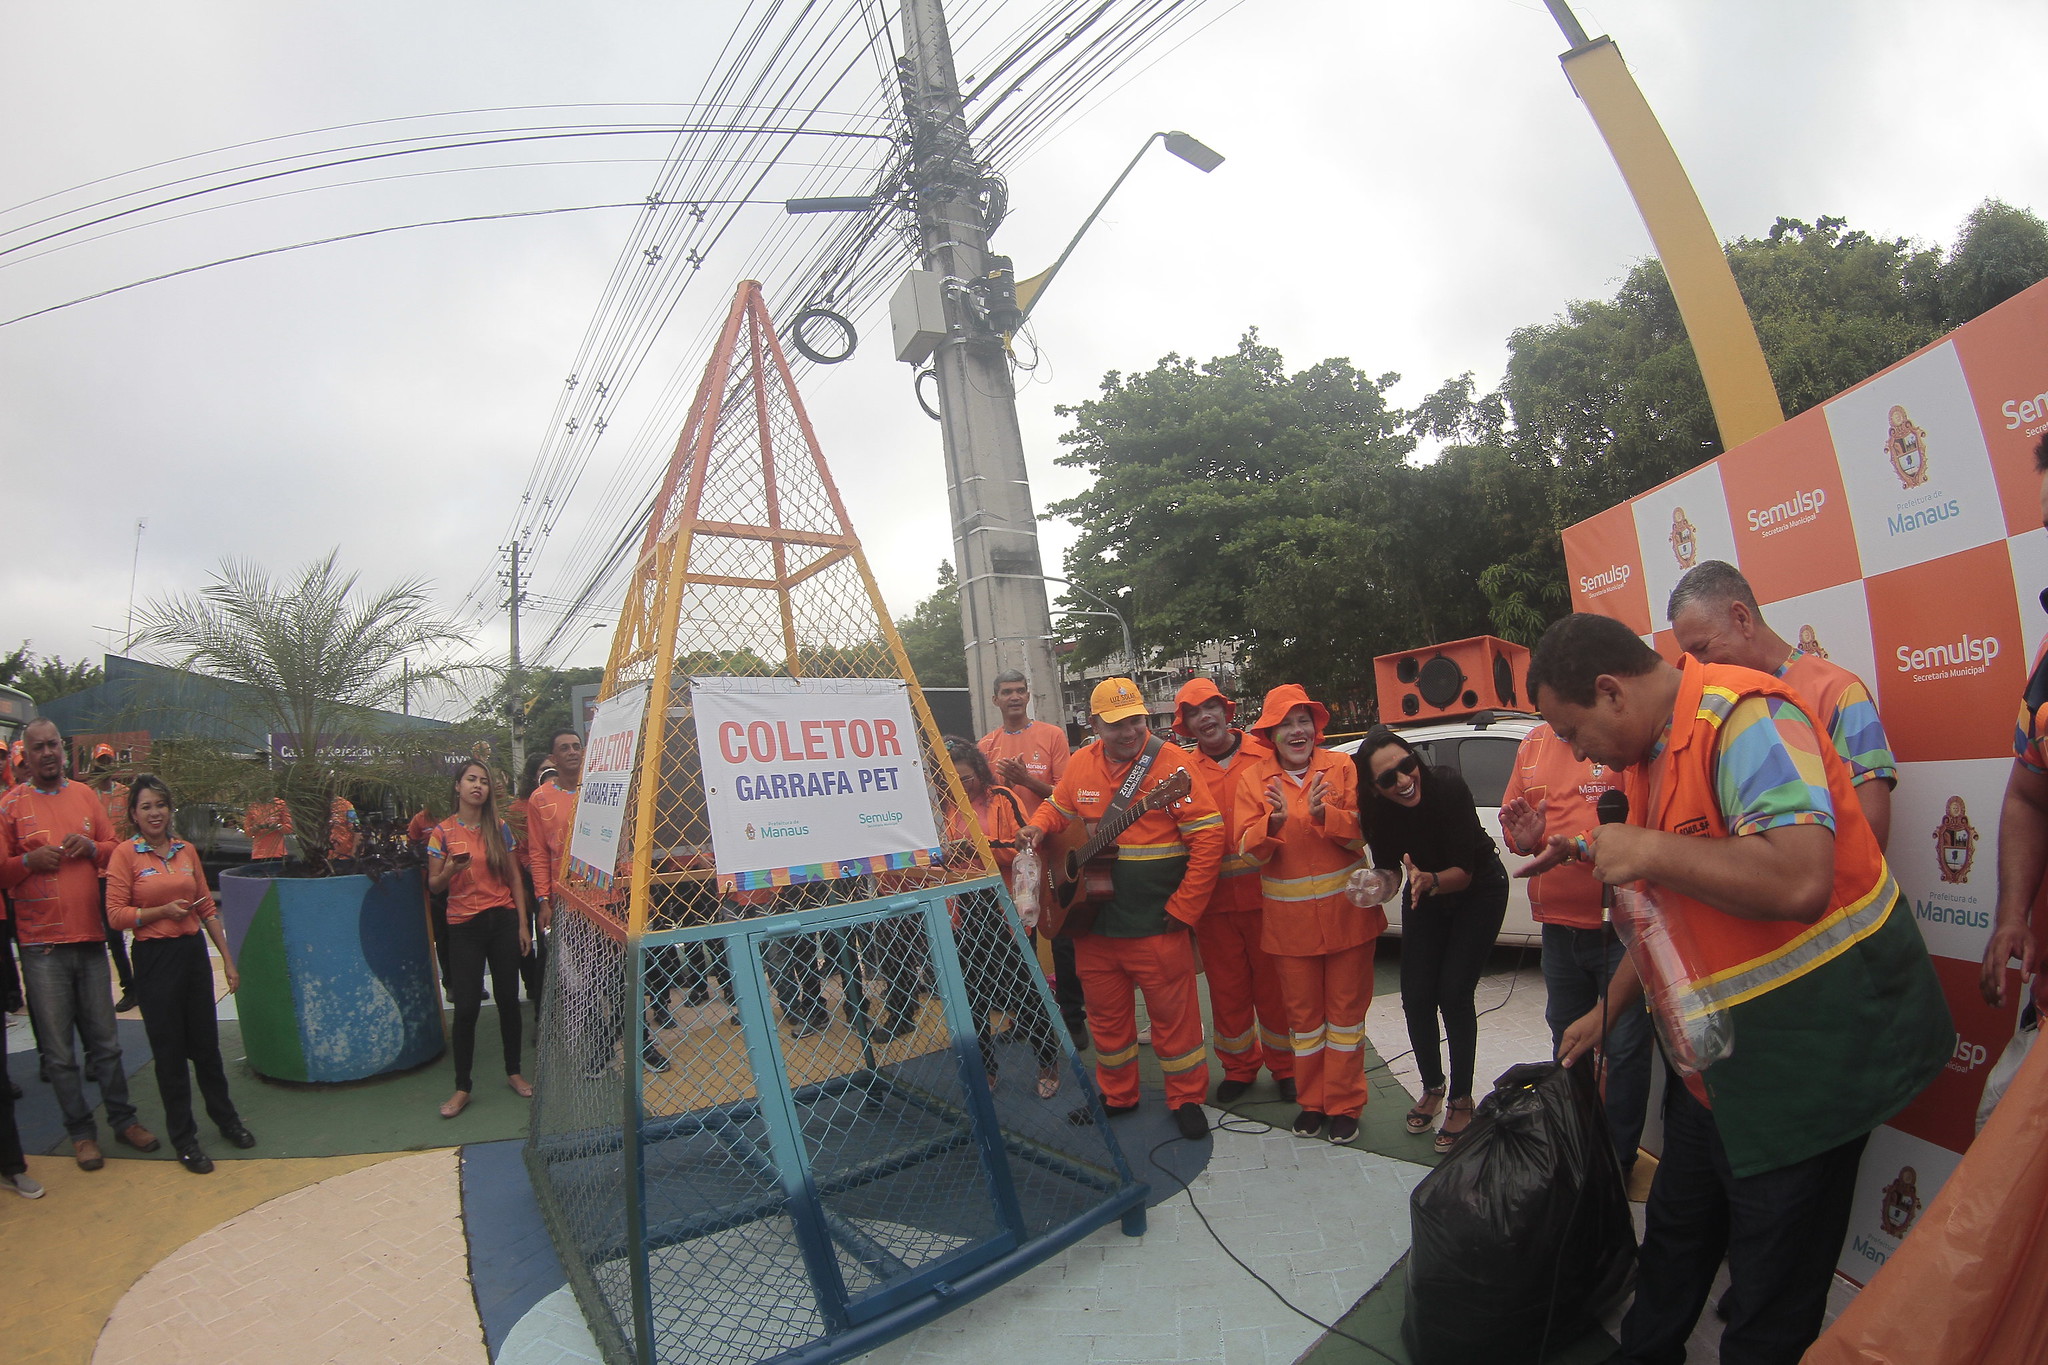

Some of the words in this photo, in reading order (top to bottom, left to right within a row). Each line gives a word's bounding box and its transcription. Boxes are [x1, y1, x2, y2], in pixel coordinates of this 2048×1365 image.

[1746, 487, 1826, 532] Semulsp
[1896, 494, 1933, 512] Prefeitura
[1933, 489, 1943, 501] de
[1761, 523, 1789, 539] Secretaria
[1789, 512, 1817, 530] Municipal
[1887, 498, 1961, 537] Manaus
[1579, 564, 1631, 593] Semulsp
[1896, 633, 1999, 672] Semulsp
[1912, 670, 1949, 683] Secretaria
[1949, 664, 1986, 678] Municipal
[588, 729, 634, 773] COLETOR
[718, 718, 902, 764] COLETOR
[584, 783, 609, 805] GARRAFA
[735, 770, 854, 802] GARRAFA
[858, 767, 899, 793] PET
[760, 826, 809, 838] Manaus
[858, 811, 903, 824] Semulsp
[1929, 891, 1966, 904] Prefeitura
[1967, 896, 1978, 904] de
[1916, 899, 1989, 929] Manaus
